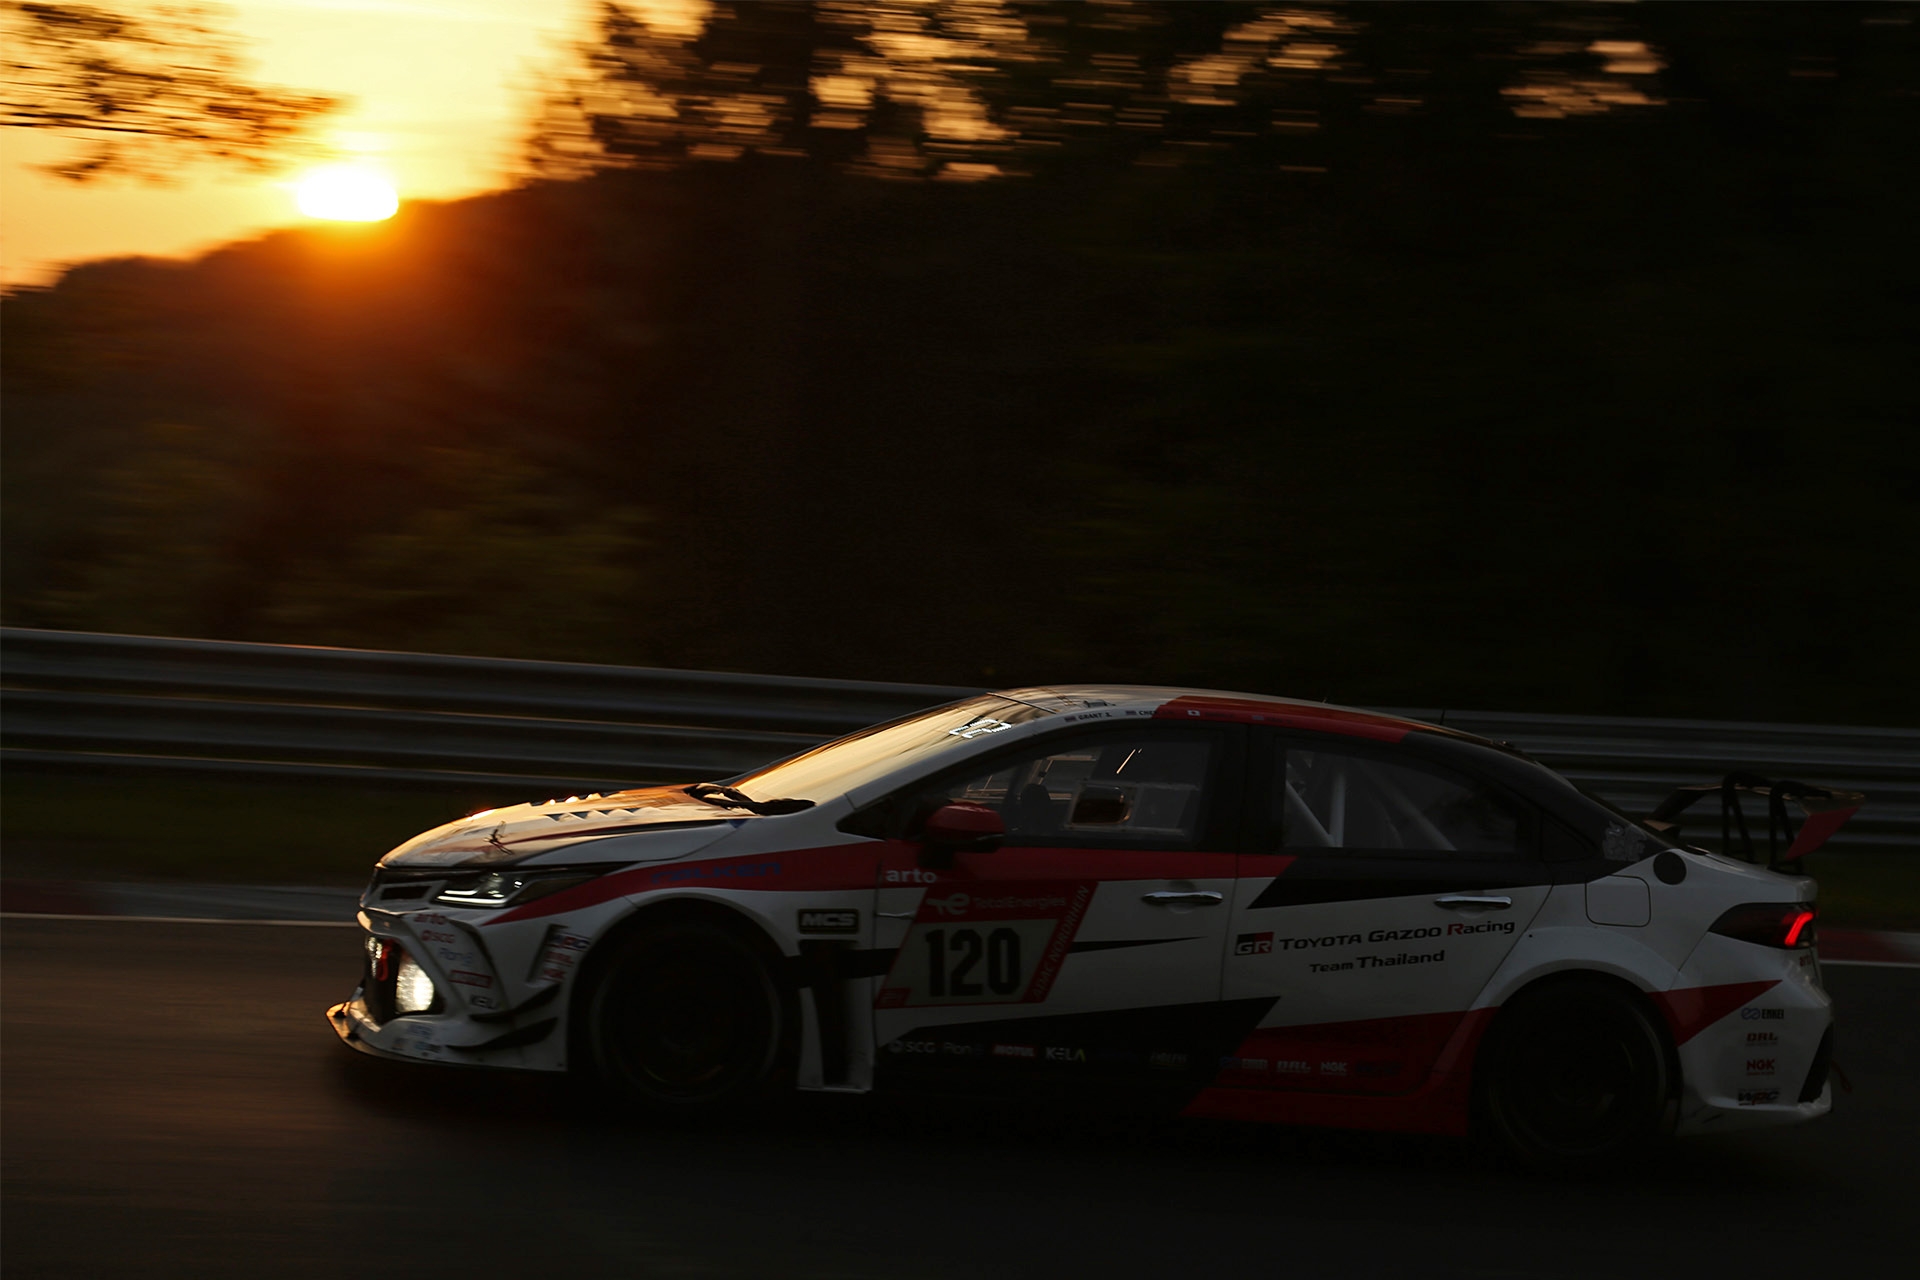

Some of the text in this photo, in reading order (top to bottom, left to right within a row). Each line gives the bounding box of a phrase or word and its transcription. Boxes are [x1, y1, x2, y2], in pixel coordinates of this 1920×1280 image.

[651, 863, 781, 884] FALKEN
[886, 867, 938, 884] arto
[801, 912, 857, 927] MCS
[1048, 885, 1089, 963] NORDRHEIN
[1280, 920, 1516, 951] TOYOTA GAZOO Racing
[1235, 938, 1273, 955] GR
[925, 927, 1021, 997] 120
[1310, 949, 1445, 973] Team Thailand
[1746, 1058, 1776, 1072] NGK
